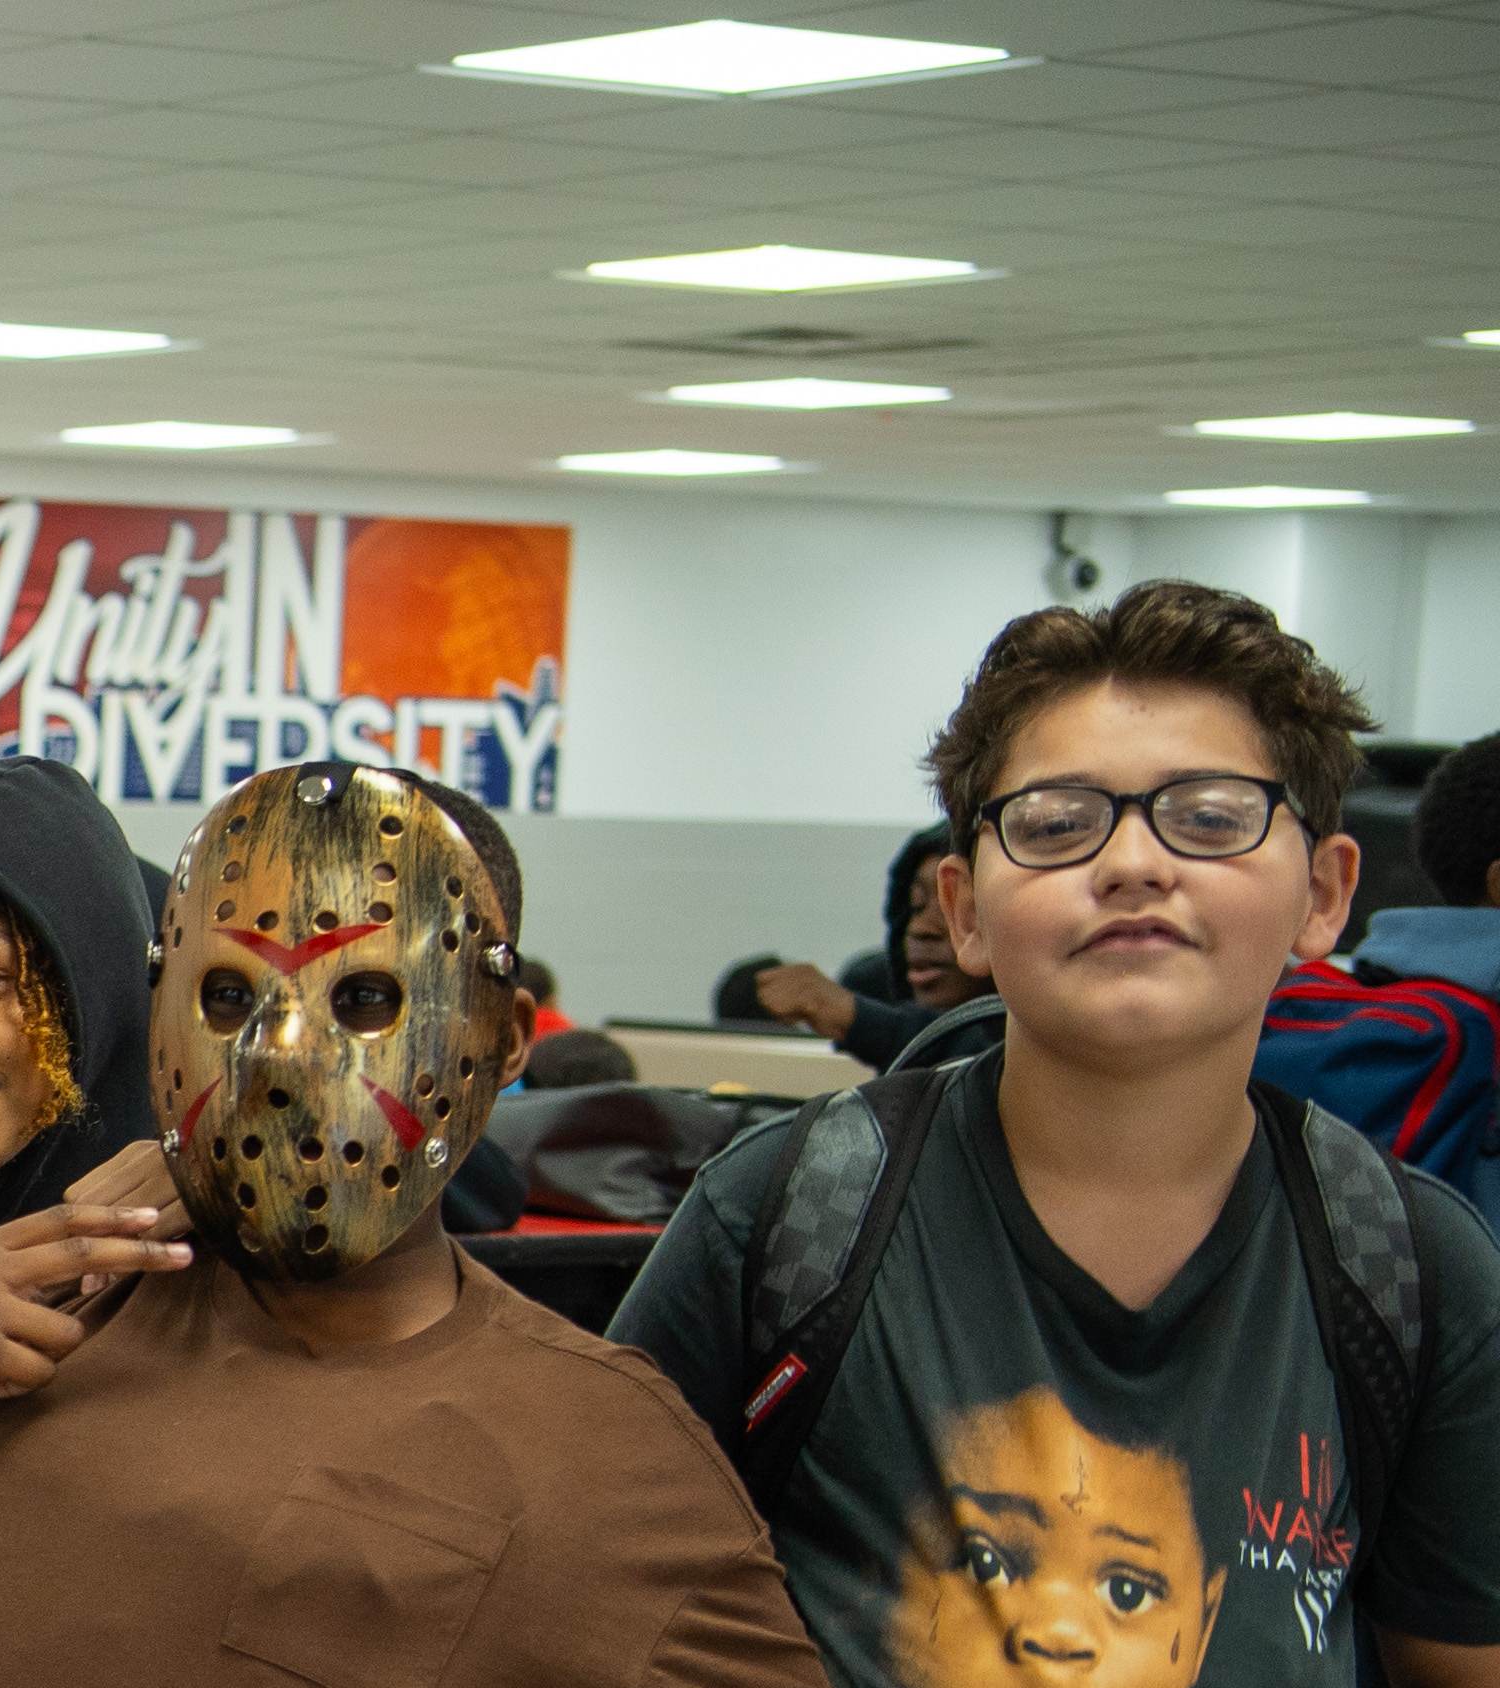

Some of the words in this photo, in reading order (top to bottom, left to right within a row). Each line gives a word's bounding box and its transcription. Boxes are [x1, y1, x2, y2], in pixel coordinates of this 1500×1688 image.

[218, 508, 346, 701] IN
[17, 693, 560, 811] DIVERSITY
[1239, 1539, 1297, 1575] THA
